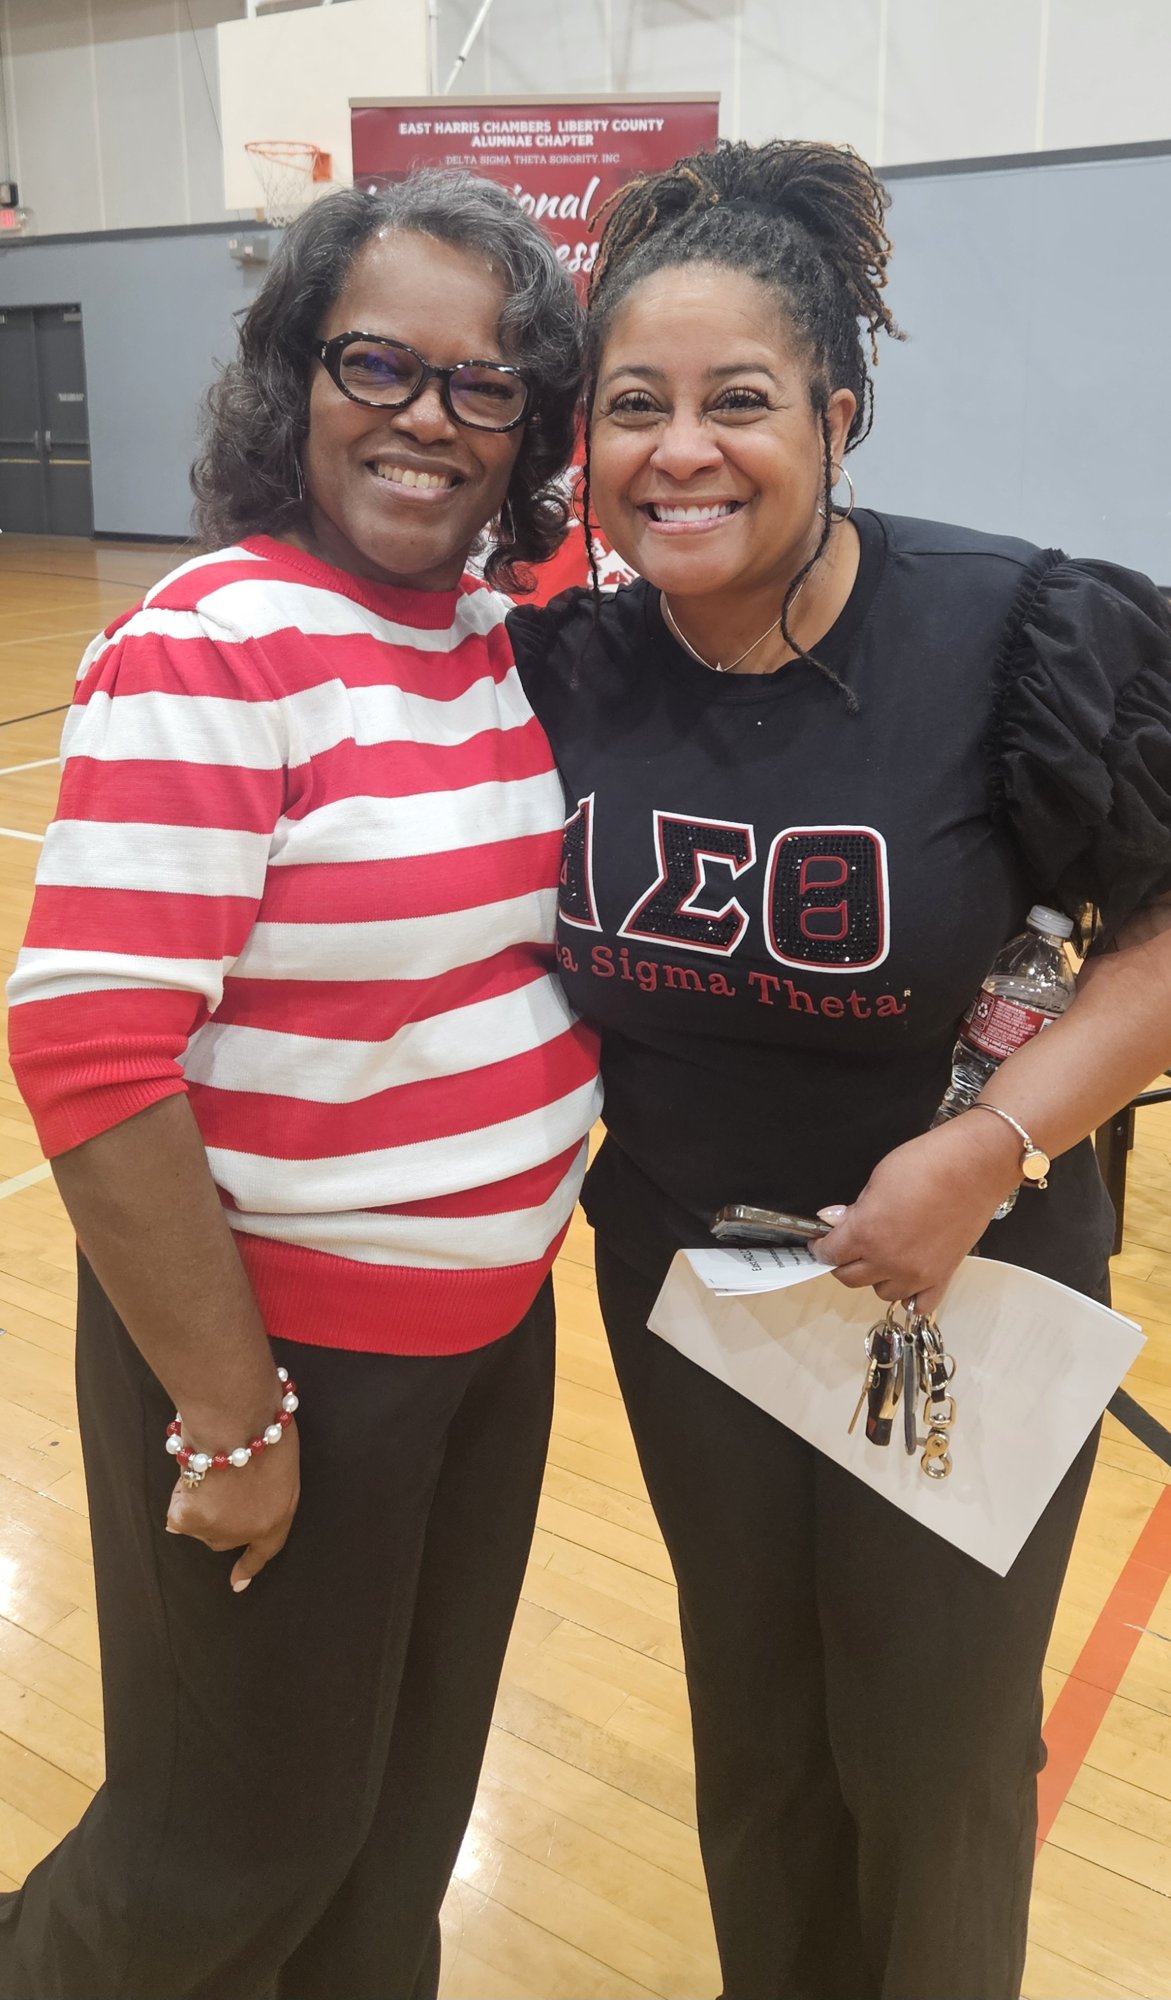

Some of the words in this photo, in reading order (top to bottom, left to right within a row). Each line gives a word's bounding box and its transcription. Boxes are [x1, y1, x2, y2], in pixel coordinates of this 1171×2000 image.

[399, 122, 431, 135] EAST
[435, 121, 480, 134] HARRIS
[483, 120, 552, 134] CHAMBERS
[557, 119, 609, 132] LIBERTY
[612, 118, 664, 132] COUNTY
[471, 135, 533, 147] ALUMNAE
[535, 133, 594, 147] CHAPTER
[446, 154, 477, 165] DELTA
[480, 154, 511, 165] SIGMA
[514, 153, 547, 165] THETA
[591, 945, 736, 997] Sigma
[748, 971, 906, 1019] Theta
